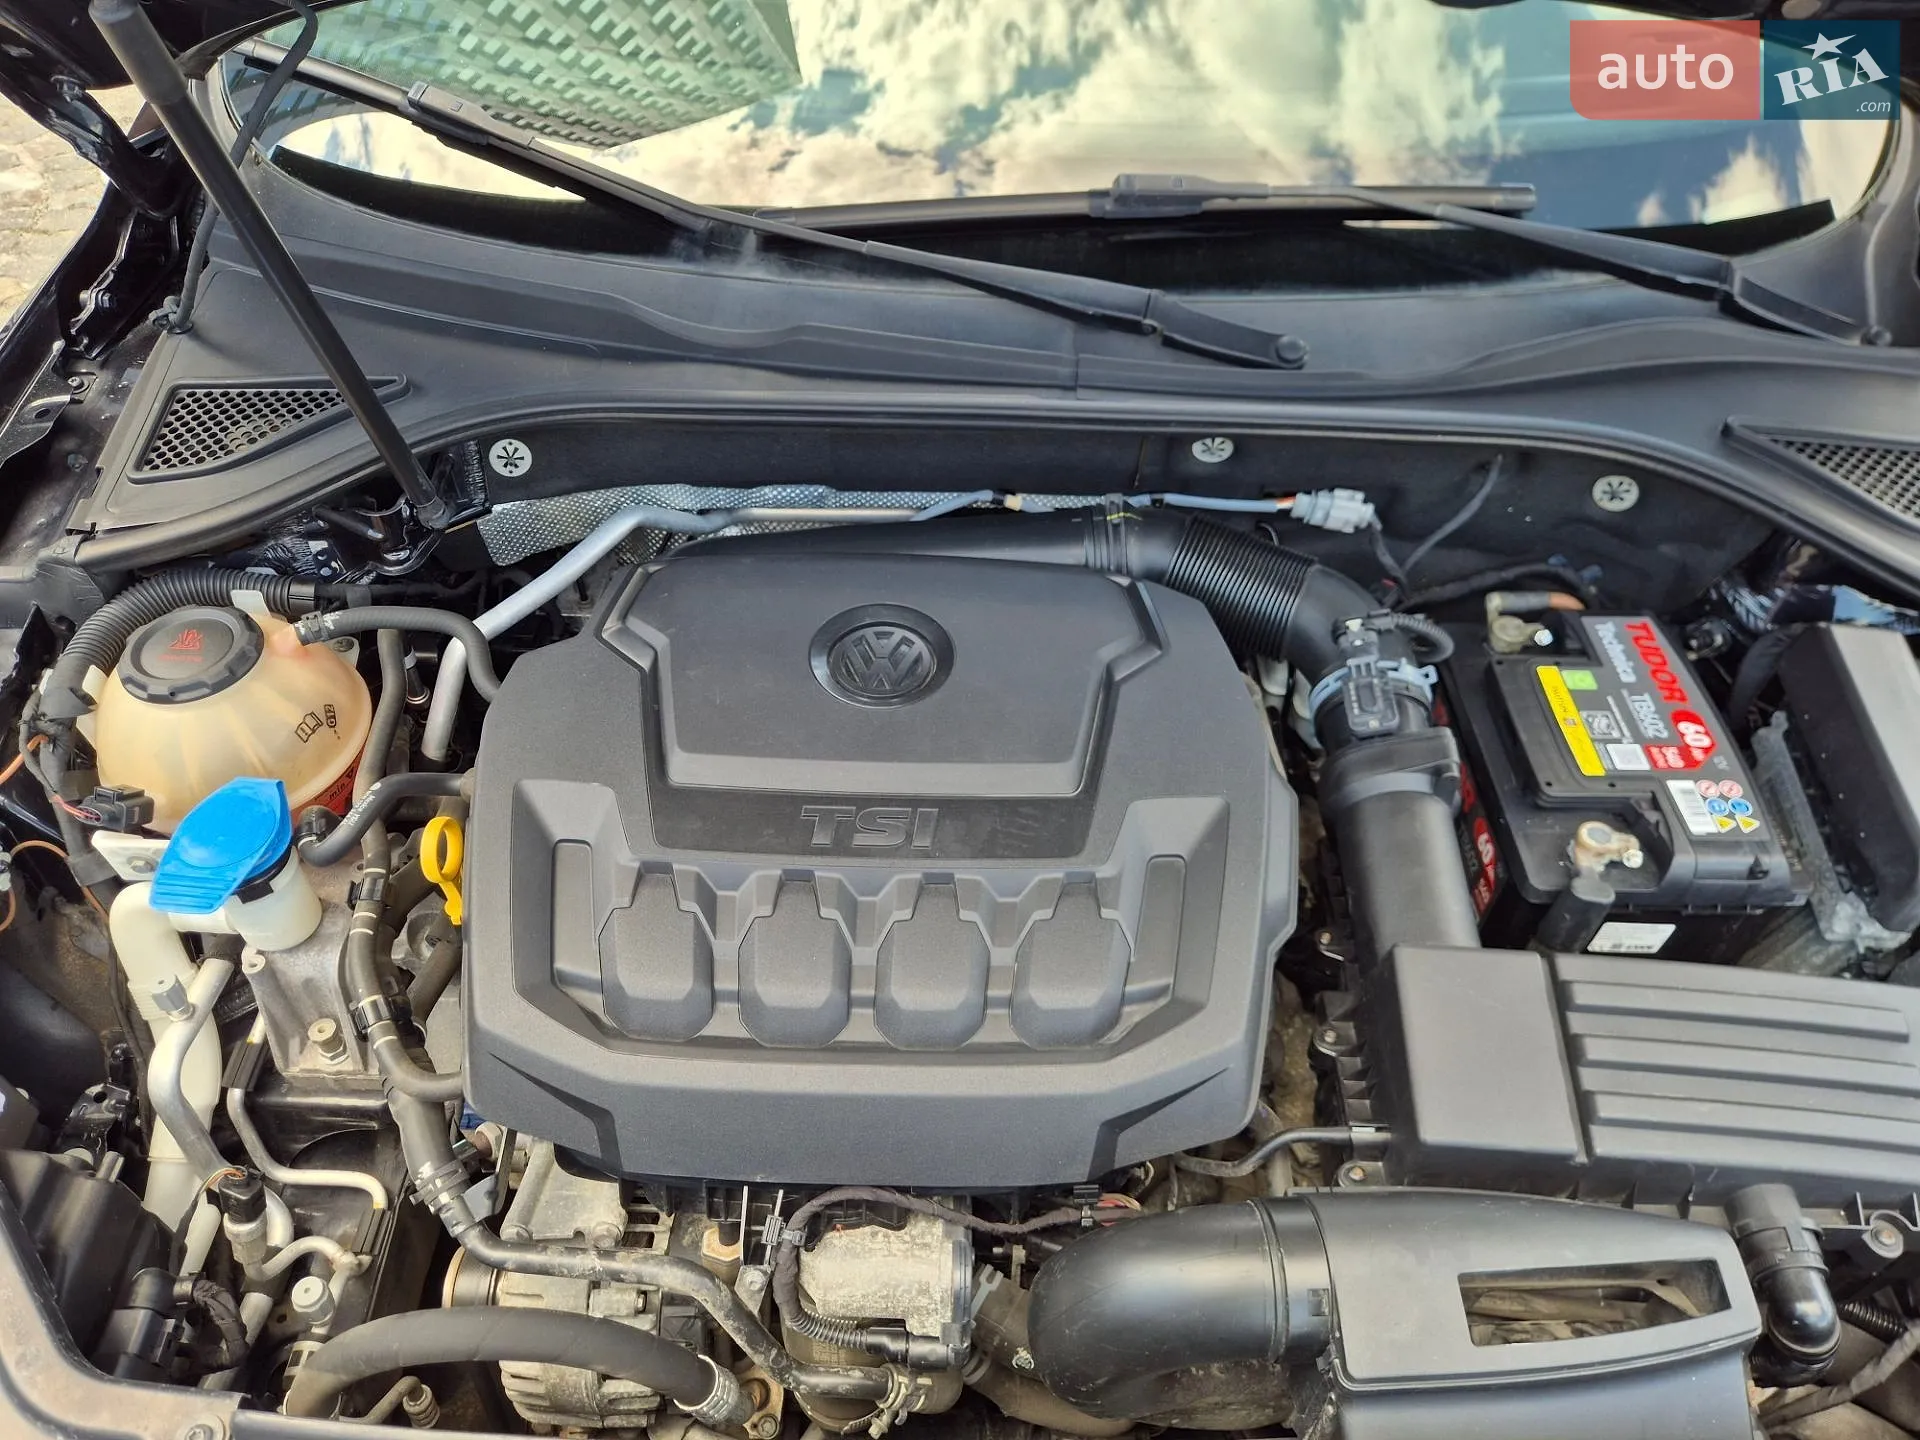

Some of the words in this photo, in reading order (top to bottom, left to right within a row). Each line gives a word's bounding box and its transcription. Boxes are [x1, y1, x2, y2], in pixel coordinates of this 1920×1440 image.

[823, 617, 944, 702] VW
[1594, 620, 1637, 684] Technica
[1625, 621, 1689, 704] TUDOR
[1676, 720, 1713, 748] 60
[329, 782, 346, 801] min
[801, 805, 939, 850] TSI
